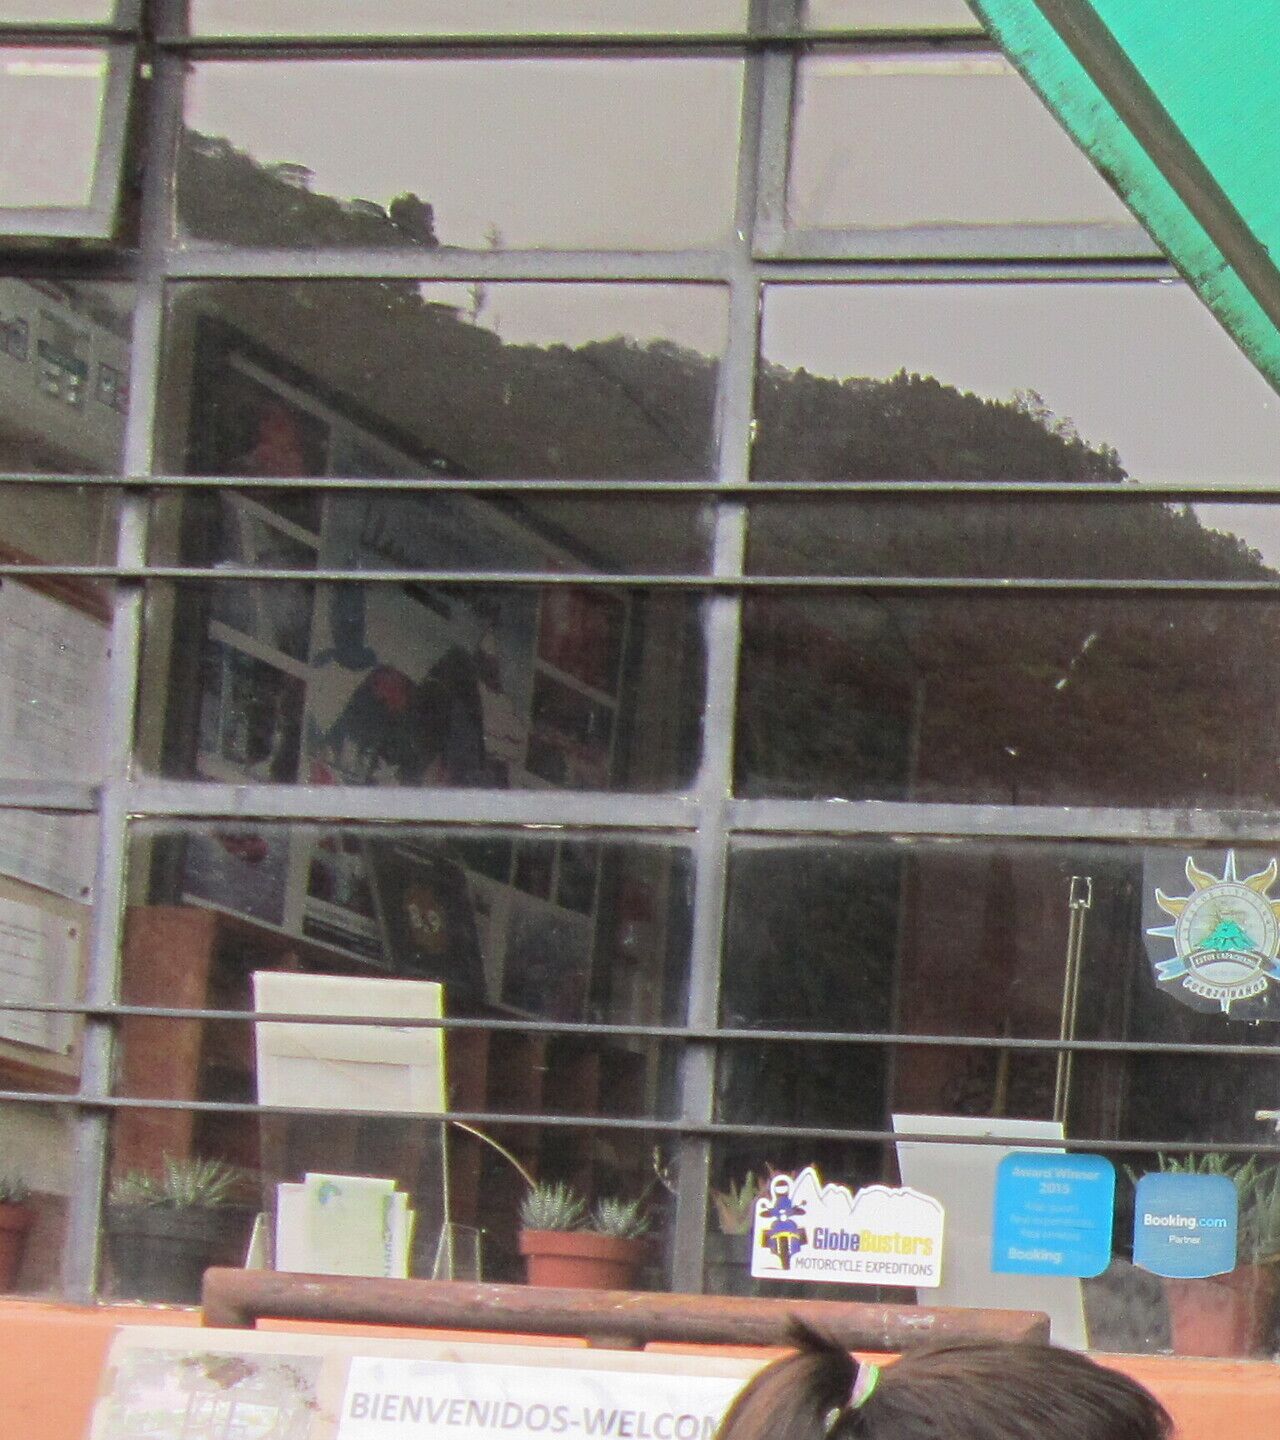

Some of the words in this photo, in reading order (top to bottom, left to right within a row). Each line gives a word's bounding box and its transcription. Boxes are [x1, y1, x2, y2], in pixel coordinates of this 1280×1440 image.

[1143, 1214, 1228, 1230] Booking.com
[813, 1227, 933, 1256] GlobeBusters
[1169, 1234, 1201, 1245] Partner
[795, 1257, 862, 1273] MOTORCYCLE
[866, 1261, 934, 1277] EXPEDITIONS
